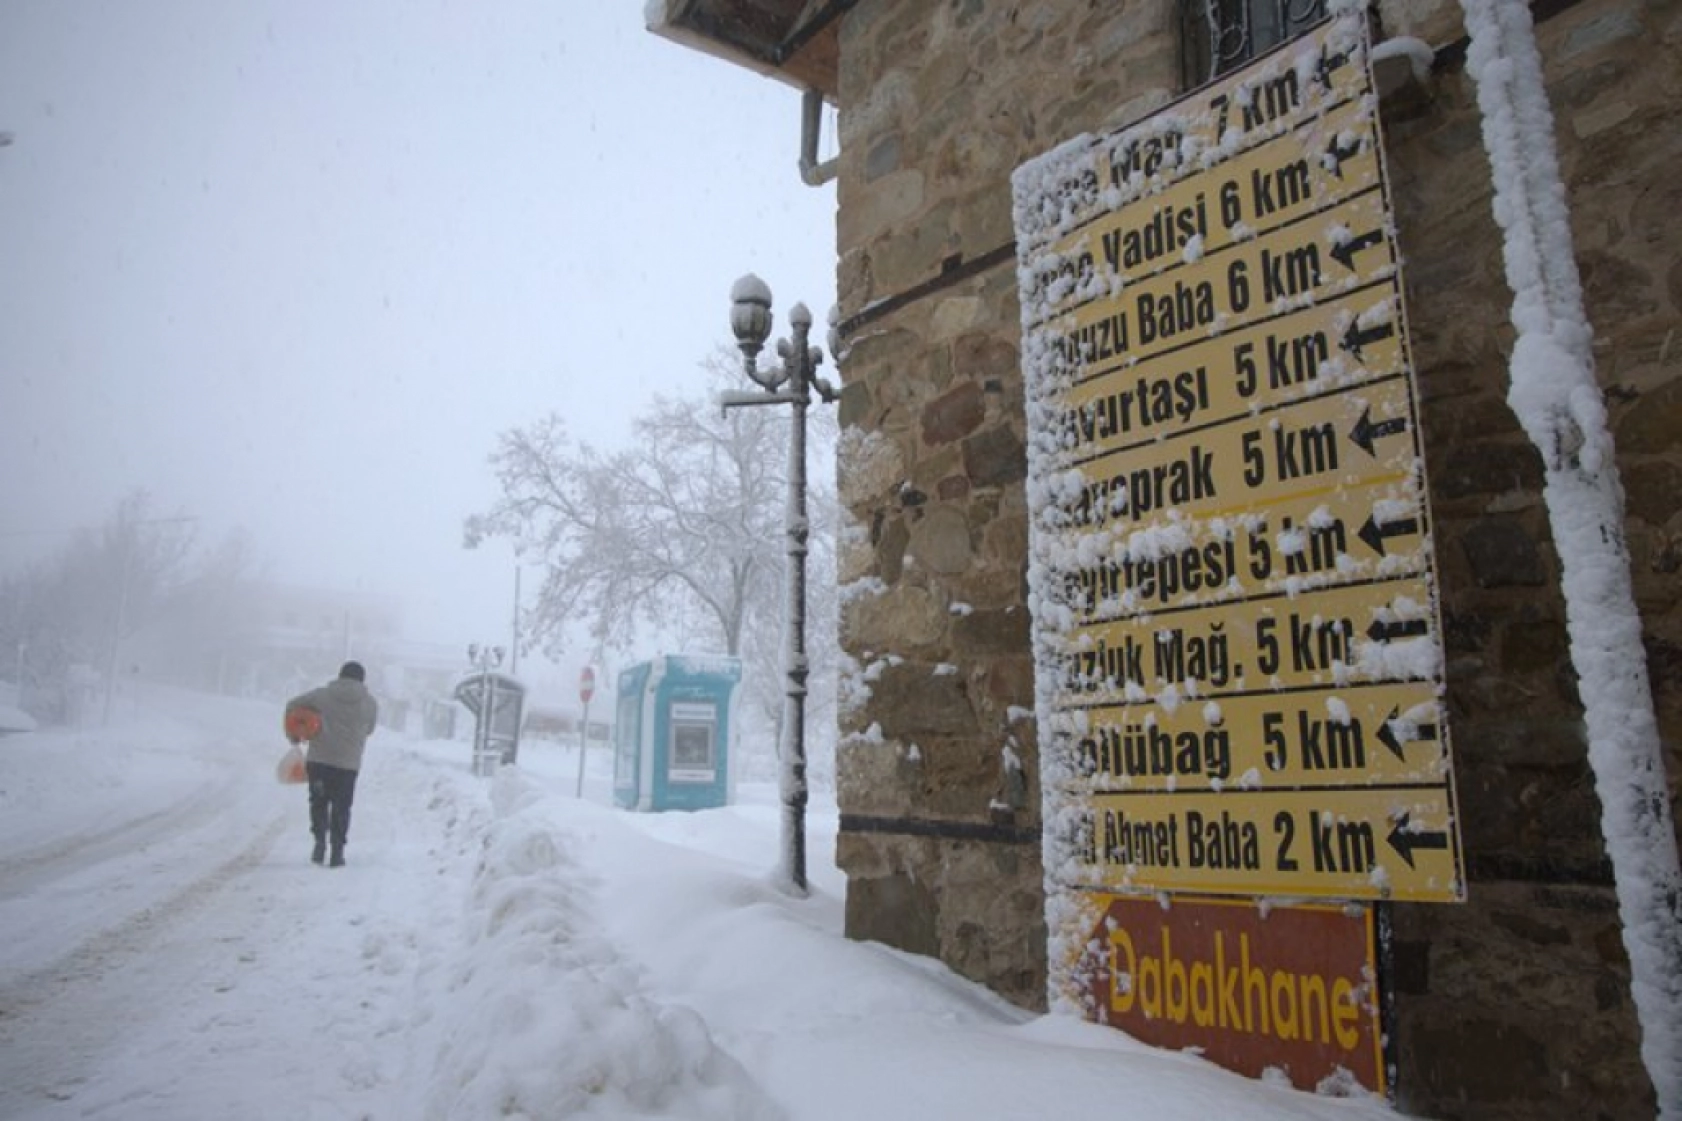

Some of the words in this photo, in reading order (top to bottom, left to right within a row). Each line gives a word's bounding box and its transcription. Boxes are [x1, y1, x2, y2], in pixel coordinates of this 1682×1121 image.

[1210, 94, 1229, 144] 7
[1240, 67, 1299, 133] km
[1102, 194, 1207, 274] Vadisi
[1220, 181, 1241, 229] 6
[1252, 157, 1312, 219] km
[1137, 280, 1214, 345] Baba
[1228, 259, 1249, 313] 6
[1262, 242, 1322, 303] km
[1234, 342, 1256, 398] 5
[1268, 328, 1328, 390] km
[1242, 430, 1264, 487] 5
[1276, 420, 1338, 480] km
[1248, 518, 1271, 581] 5
[1154, 621, 1243, 688] Mağ.
[1257, 617, 1279, 675] 5
[1290, 613, 1353, 672] km
[1263, 712, 1286, 770] 5
[1299, 710, 1365, 769] km
[1104, 810, 1180, 868] Ahmet
[1187, 810, 1259, 870] Baba
[1274, 811, 1298, 872] 2
[1311, 811, 1375, 874] km
[1109, 926, 1360, 1050] Dabakhane
